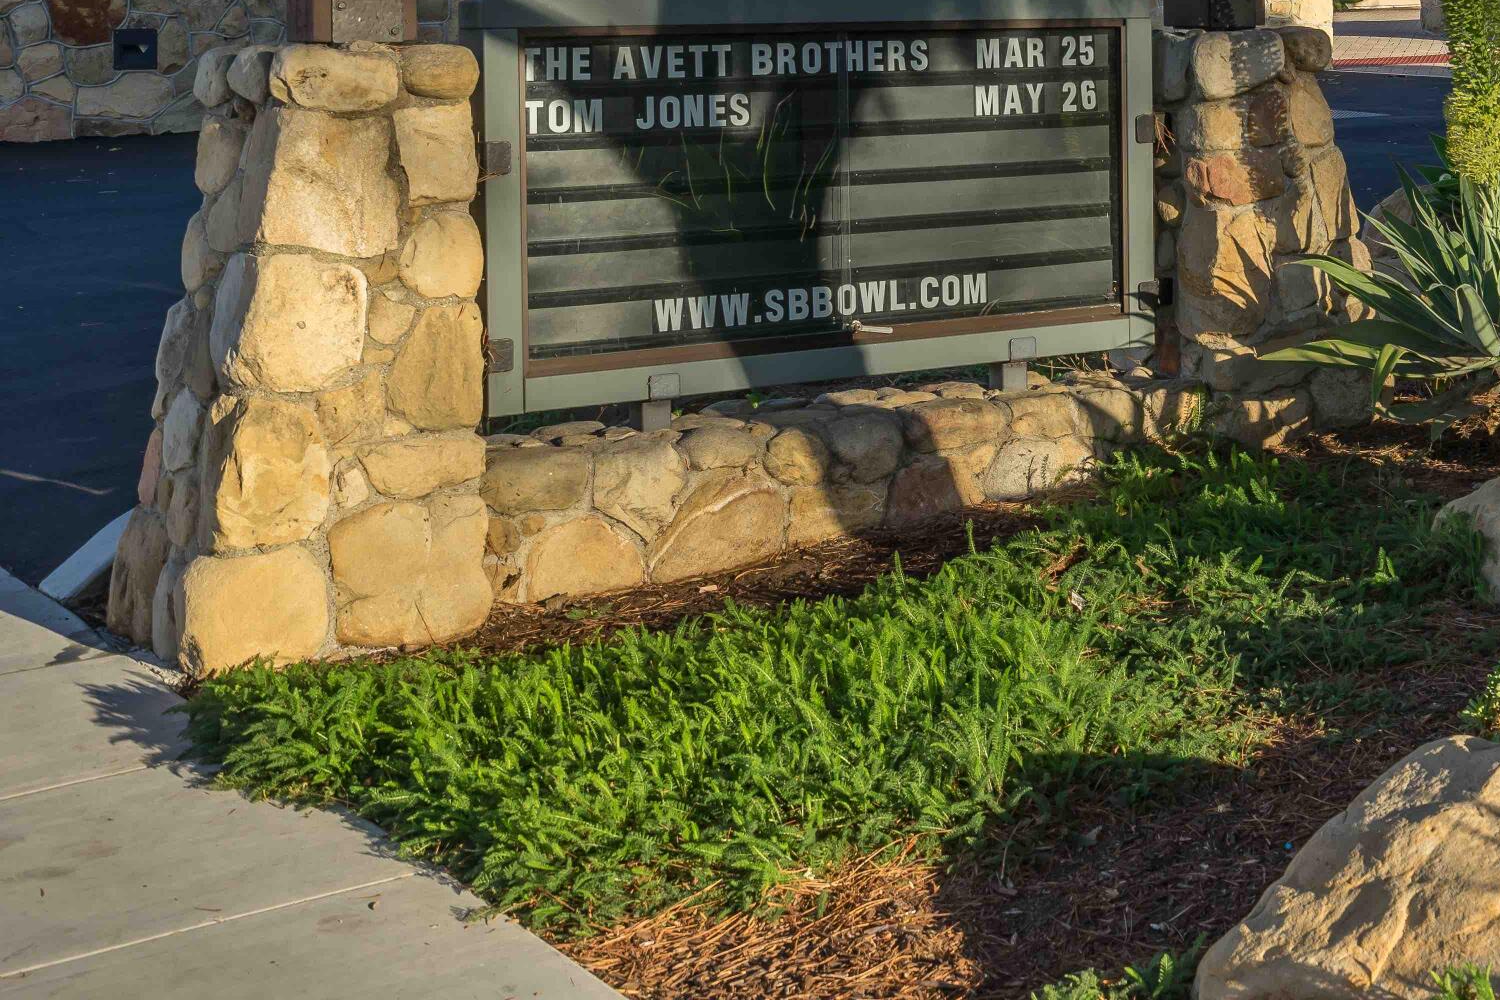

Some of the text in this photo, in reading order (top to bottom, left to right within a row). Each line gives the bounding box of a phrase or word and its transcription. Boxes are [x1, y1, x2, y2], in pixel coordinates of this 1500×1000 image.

[525, 35, 1094, 82] THE AVETT BROTHERS MAR 25
[525, 80, 1097, 134] TOM JONES MAY 26
[654, 272, 988, 333] WWW.SBBOWL.COM
